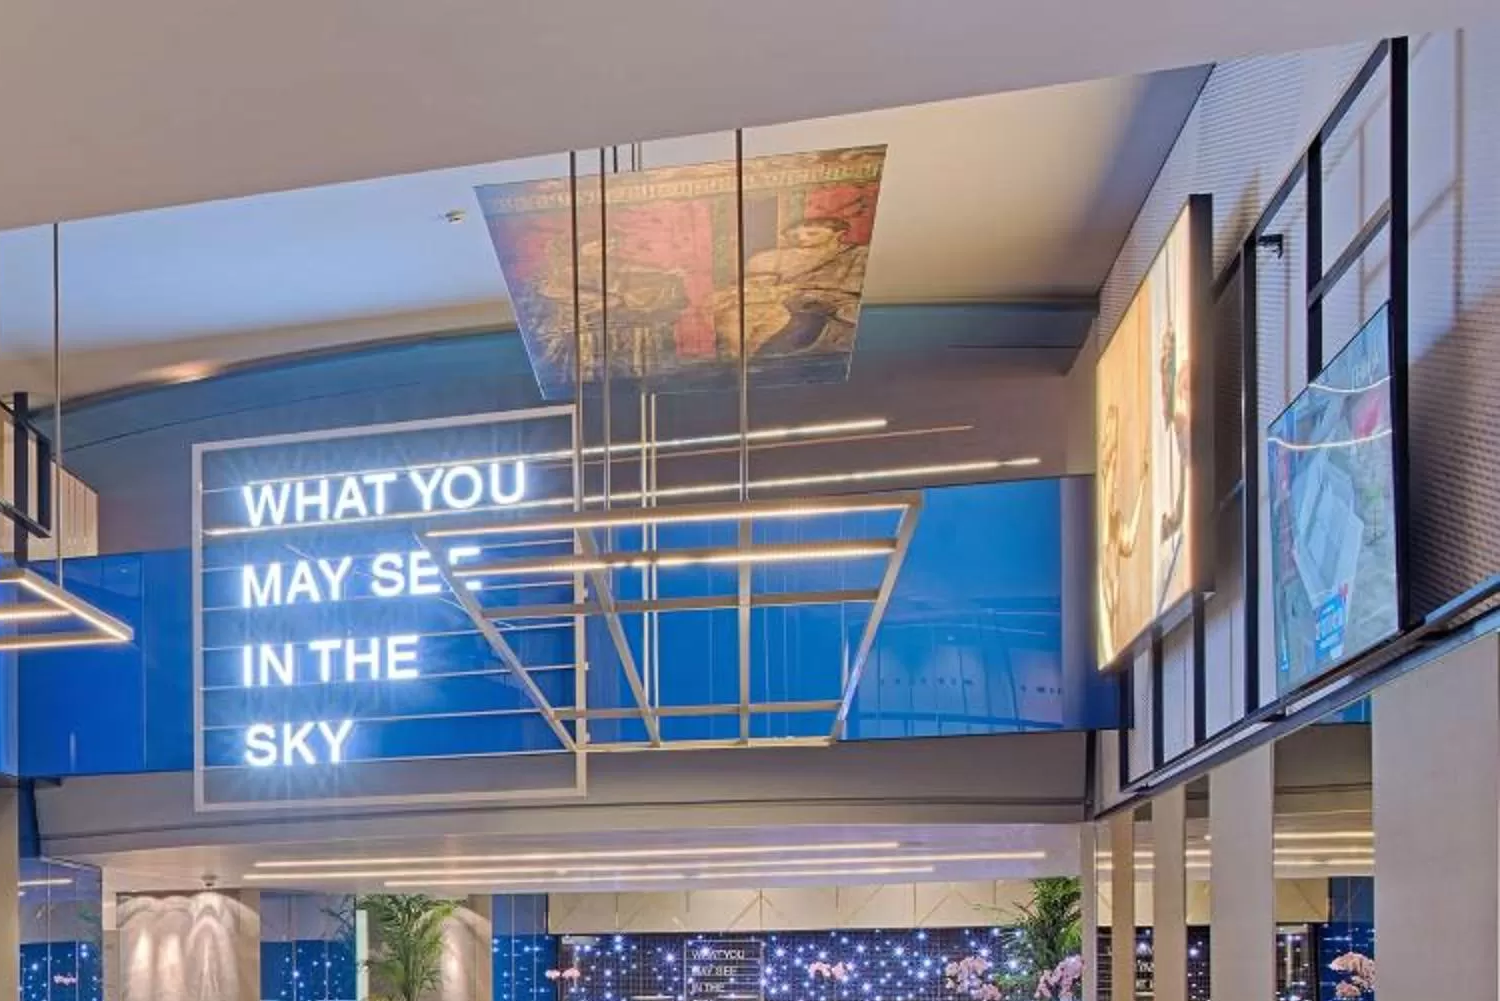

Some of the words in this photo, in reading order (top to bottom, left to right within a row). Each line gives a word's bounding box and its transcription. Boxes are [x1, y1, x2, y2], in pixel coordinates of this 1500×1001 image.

[242, 472, 398, 528] WHAT
[409, 460, 527, 512] YOU
[241, 556, 353, 608] MAY
[243, 642, 295, 687] IN
[309, 634, 420, 682] THE
[244, 719, 354, 768] SKY
